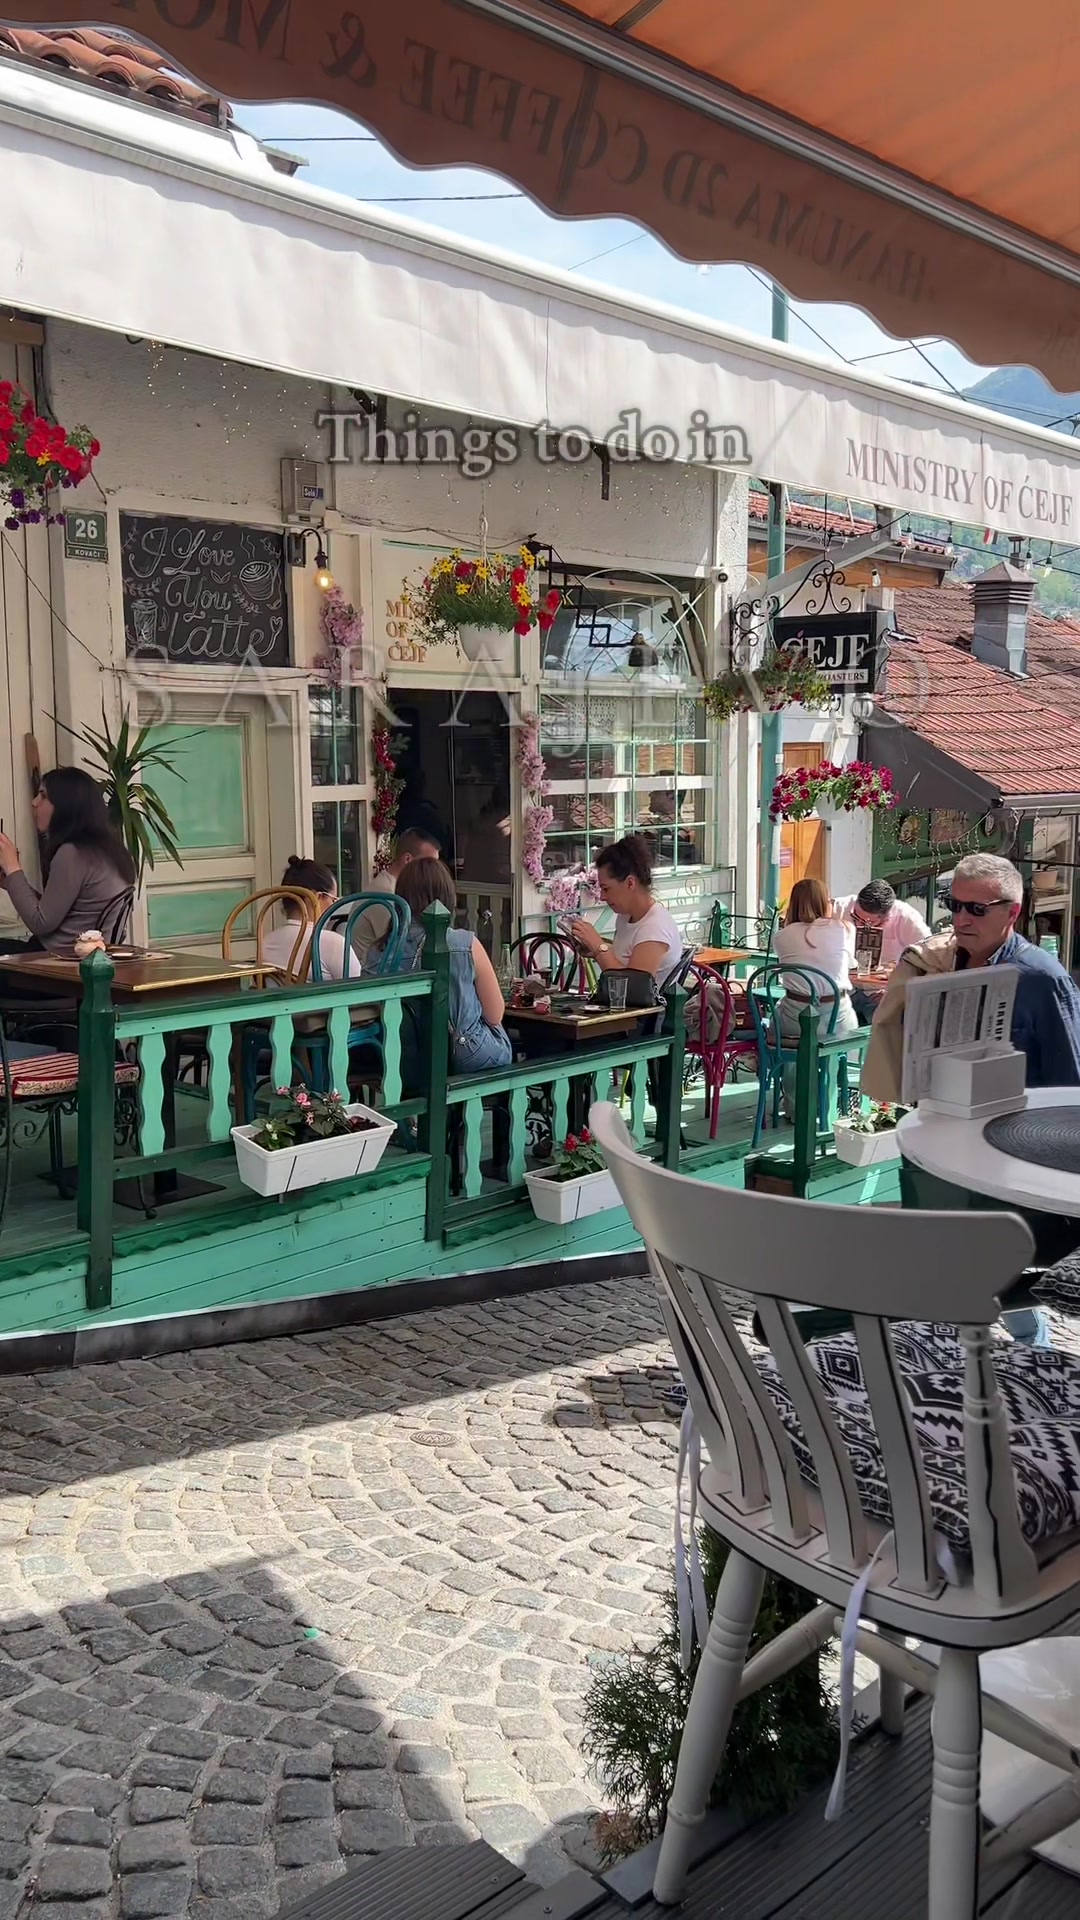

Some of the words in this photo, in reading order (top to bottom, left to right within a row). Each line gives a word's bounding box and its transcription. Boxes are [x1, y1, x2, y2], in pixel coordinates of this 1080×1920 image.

[846, 437, 978, 505] MINISTRY
[983, 475, 1014, 513] OF
[1018, 475, 1074, 527] ĆEJF
[75, 518, 98, 539] 26
[162, 527, 236, 576] Love
[165, 574, 232, 622] You
[385, 621, 409, 638] OF
